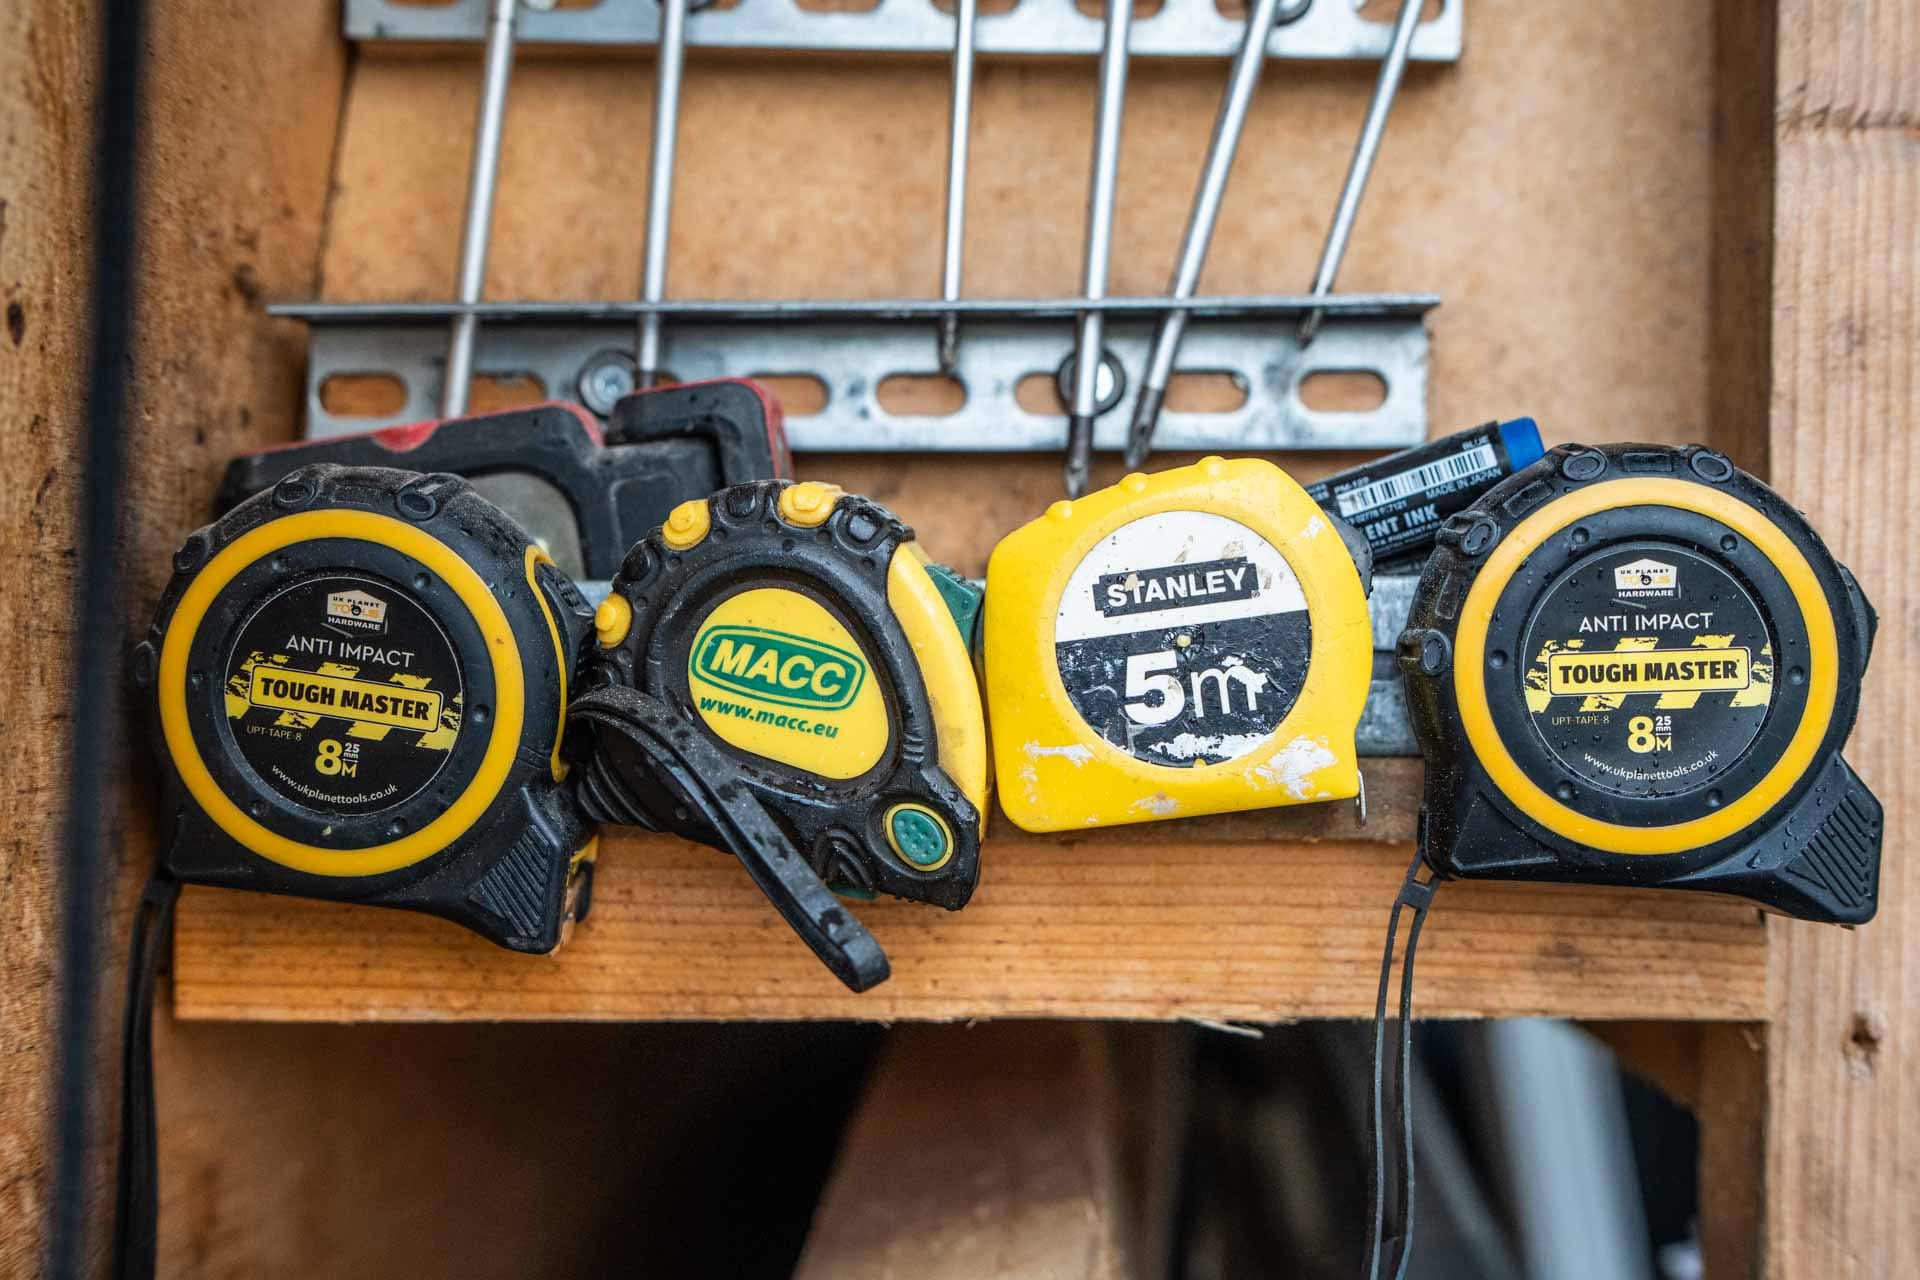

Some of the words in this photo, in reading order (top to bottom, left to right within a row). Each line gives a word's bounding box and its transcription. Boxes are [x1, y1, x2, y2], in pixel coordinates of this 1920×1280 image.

[1425, 481, 1457, 500] MADE
[1456, 478, 1470, 490] IN
[1469, 468, 1503, 486] JAPAN
[1364, 516, 1399, 540] ENT
[1403, 503, 1439, 529] INK
[1107, 567, 1247, 608] STANLEY
[1618, 589, 1674, 598] HARDWARE
[347, 599, 380, 608] PLANET
[327, 616, 381, 631] HARDWARE
[1578, 614, 1627, 633] ANTI
[1635, 612, 1714, 631] IMPACT
[285, 635, 333, 657] ANTI
[339, 642, 415, 668] IMPACT
[709, 639, 847, 697] MACC
[1559, 663, 1638, 685] TOUGH
[1643, 660, 1739, 682] MASTER
[260, 677, 335, 706] TOUGH
[340, 692, 430, 721] MASTER
[1123, 650, 1262, 725] 5m
[699, 696, 840, 740] www.macc.eu
[1655, 715, 1672, 726] 25
[1655, 725, 1672, 733] mm
[343, 742, 360, 754] 25
[1627, 715, 1655, 753] 8
[1655, 735, 1672, 752] M
[314, 738, 343, 776] 8
[341, 762, 357, 778] M
[343, 752, 360, 760] mm
[1583, 750, 1719, 781] www.ukplanettools.co.uk
[271, 764, 399, 804] www.ukplanettools.co.uk
